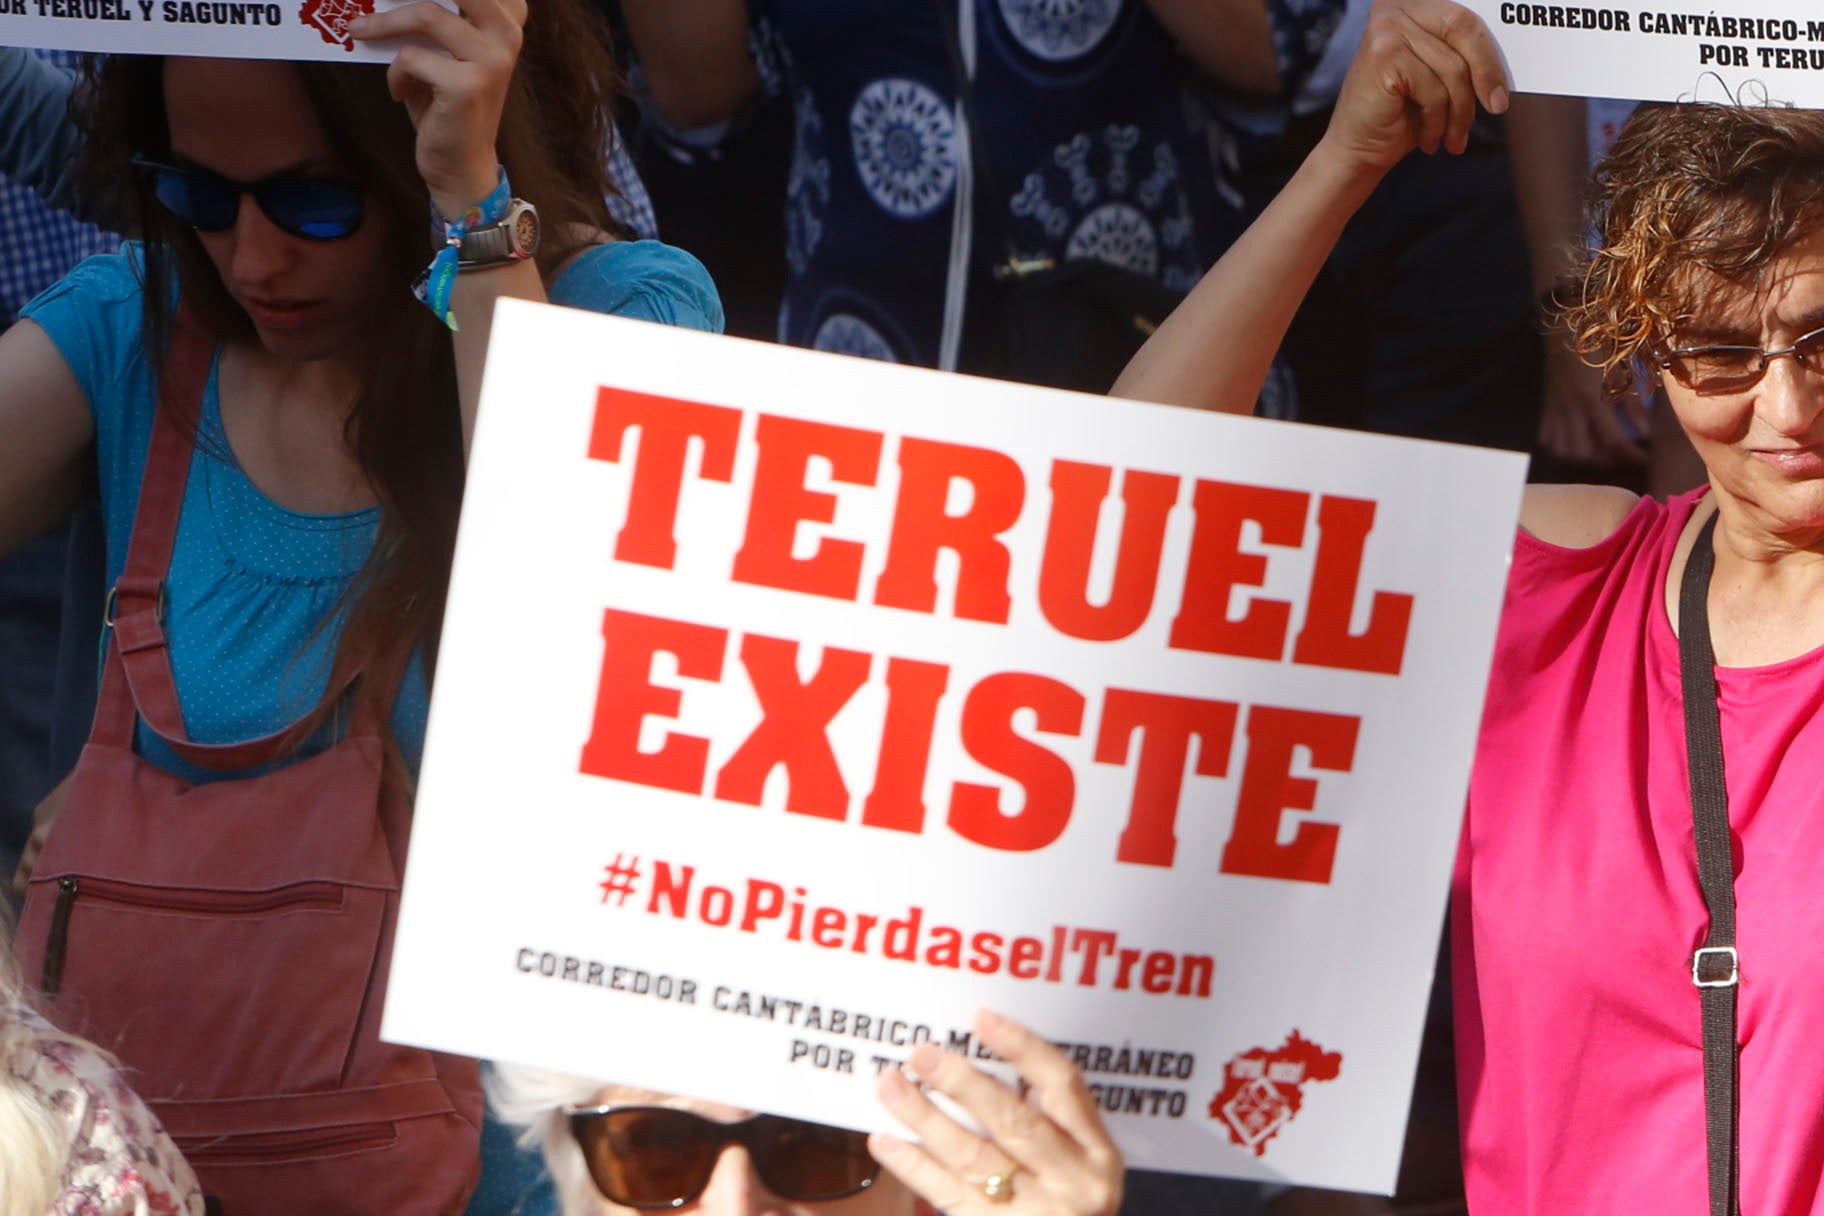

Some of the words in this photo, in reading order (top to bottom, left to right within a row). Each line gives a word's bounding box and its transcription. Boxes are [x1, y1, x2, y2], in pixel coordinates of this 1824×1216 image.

[139, 0, 156, 21] Y
[163, 2, 282, 26] SAGUNTO
[1500, 1, 1631, 32] CORREDOR
[1699, 43, 1749, 68] POR
[586, 384, 1415, 678] TERUEL
[578, 607, 1363, 885] EXISTE
[598, 852, 1215, 999] #NoPierdaselTren
[515, 947, 698, 1005] CORREDOR
[790, 1040, 857, 1074] POR
